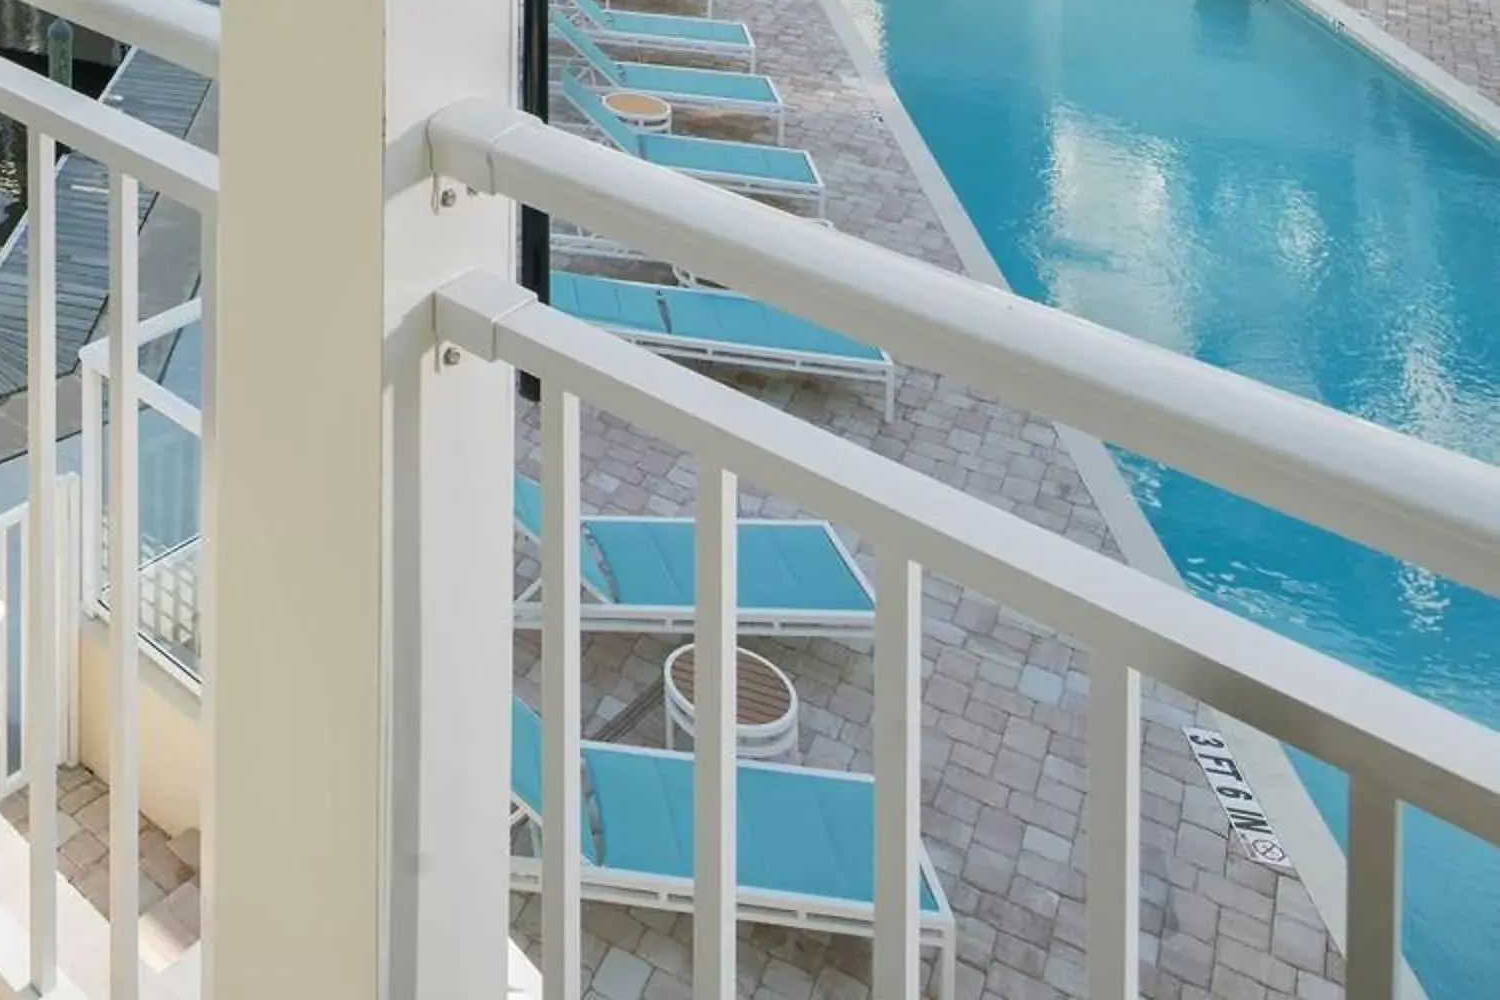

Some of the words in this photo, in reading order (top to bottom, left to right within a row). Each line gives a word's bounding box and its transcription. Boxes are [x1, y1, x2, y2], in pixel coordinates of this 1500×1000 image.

[1189, 735, 1225, 748] 3
[1198, 753, 1243, 782] FT
[1216, 786, 1253, 801] 6
[1226, 807, 1274, 835] IN
